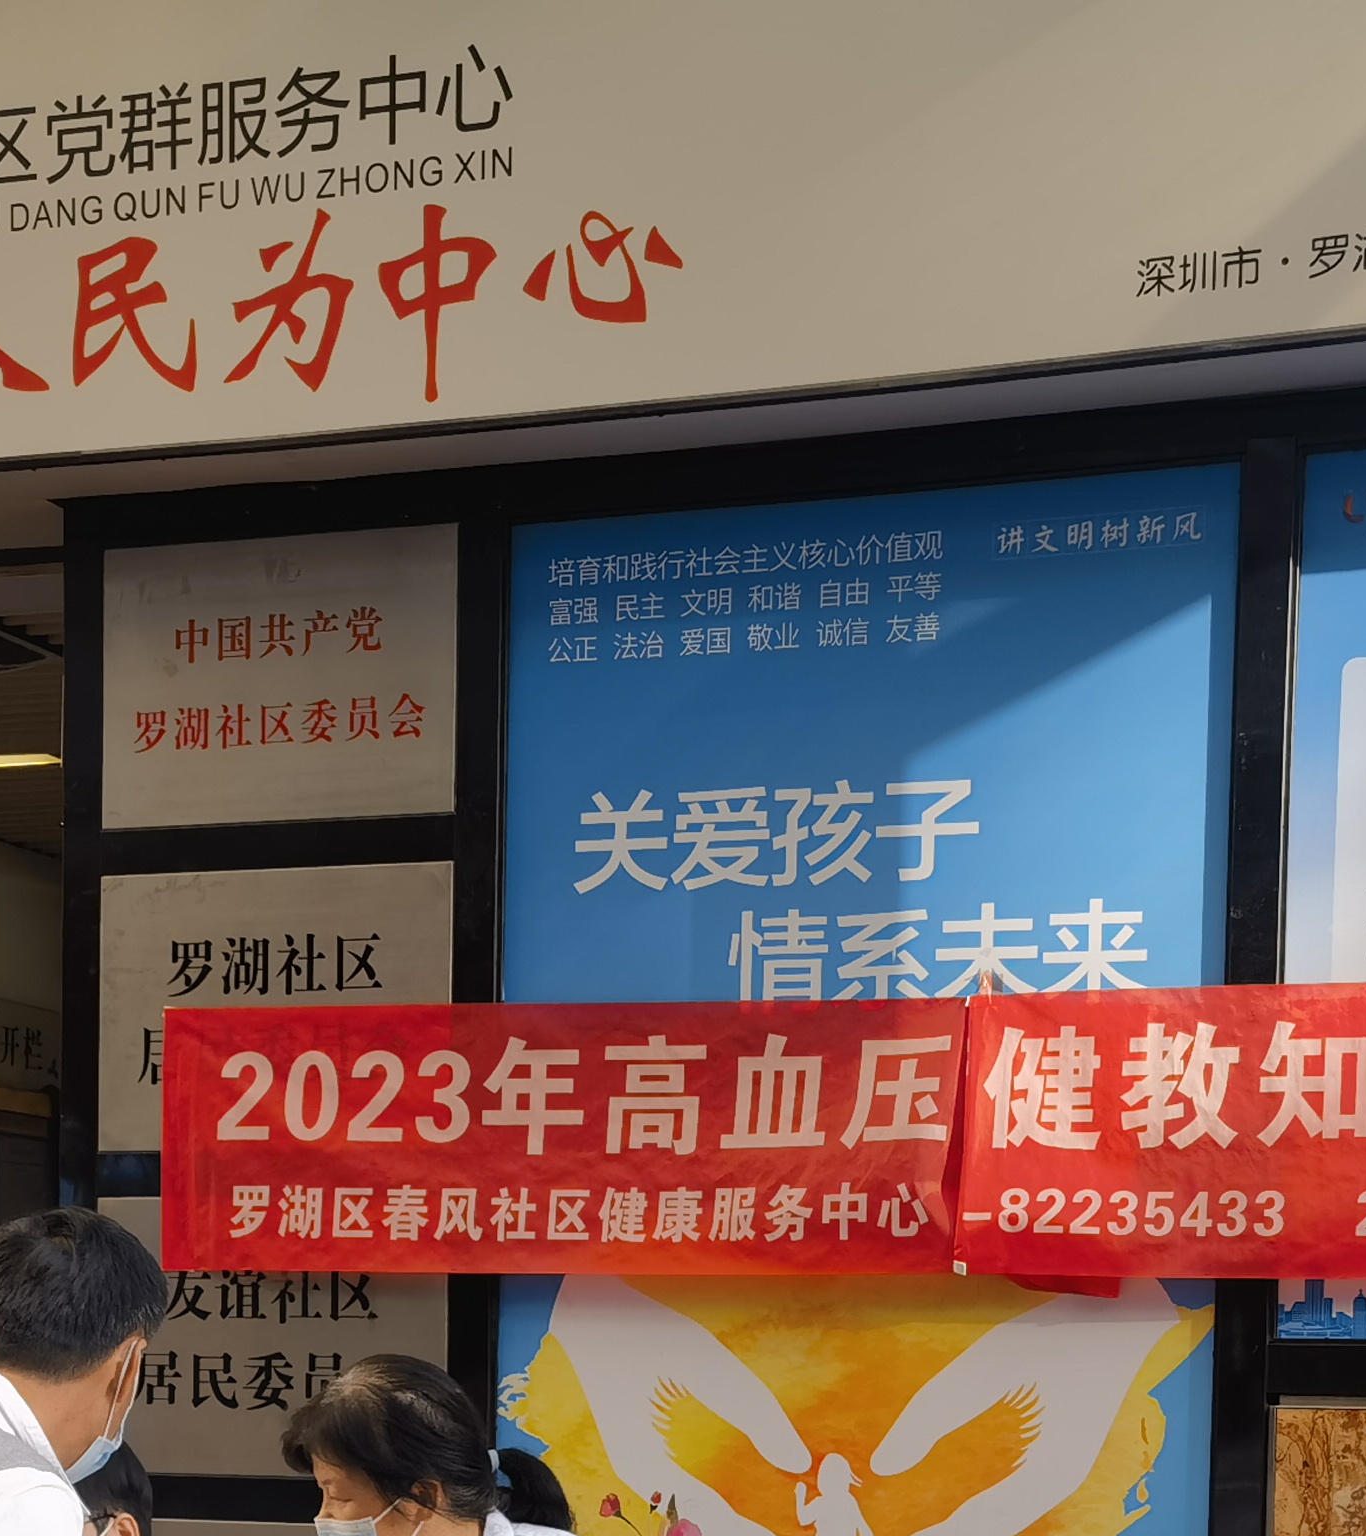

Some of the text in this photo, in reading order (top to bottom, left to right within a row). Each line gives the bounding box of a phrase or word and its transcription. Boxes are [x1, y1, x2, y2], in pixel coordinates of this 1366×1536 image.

[10, 195, 103, 232] DANG
[113, 185, 186, 221] QUN
[198, 179, 240, 212] FU
[251, 171, 306, 205] WU
[316, 156, 443, 200] ZHONG
[453, 147, 513, 184] XIN
[548, 530, 944, 588] 培育和践行社会主义核心价值观
[996, 511, 1202, 555] 讲文明树新风
[549, 571, 942, 626] 富强 民主 文明 和谐 自由 平等
[175, 606, 383, 664] 中国共产党
[547, 612, 940, 663] 公正 法治 爱国 敬业 诚信 友善
[134, 692, 426, 754] 罗湖社区委员会
[573, 779, 980, 895] 关爱孩子
[166, 932, 383, 998] 罗湖社区
[728, 898, 1150, 1002] 情系未来
[166, 1270, 378, 1324] 友谊社区
